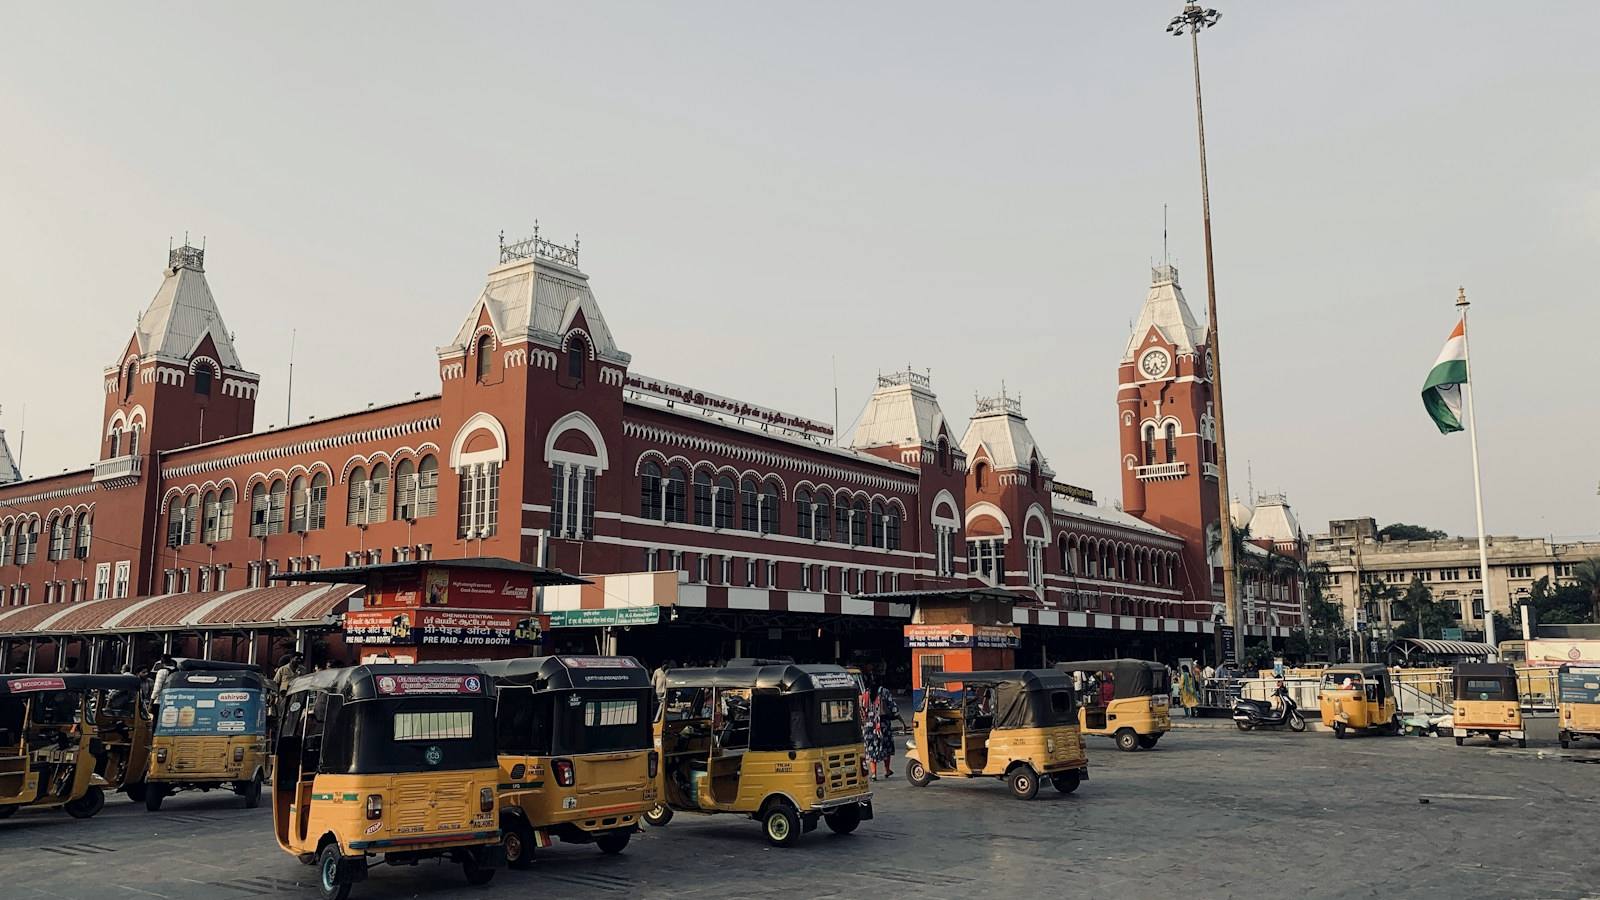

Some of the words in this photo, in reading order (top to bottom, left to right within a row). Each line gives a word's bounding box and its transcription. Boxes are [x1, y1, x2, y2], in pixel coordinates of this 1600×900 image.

[422, 635, 439, 644] PRE
[440, 636, 458, 644] PAID
[463, 637, 484, 645] AUTO
[485, 637, 511, 645] BOOTH
[366, 821, 382, 834] STOP
